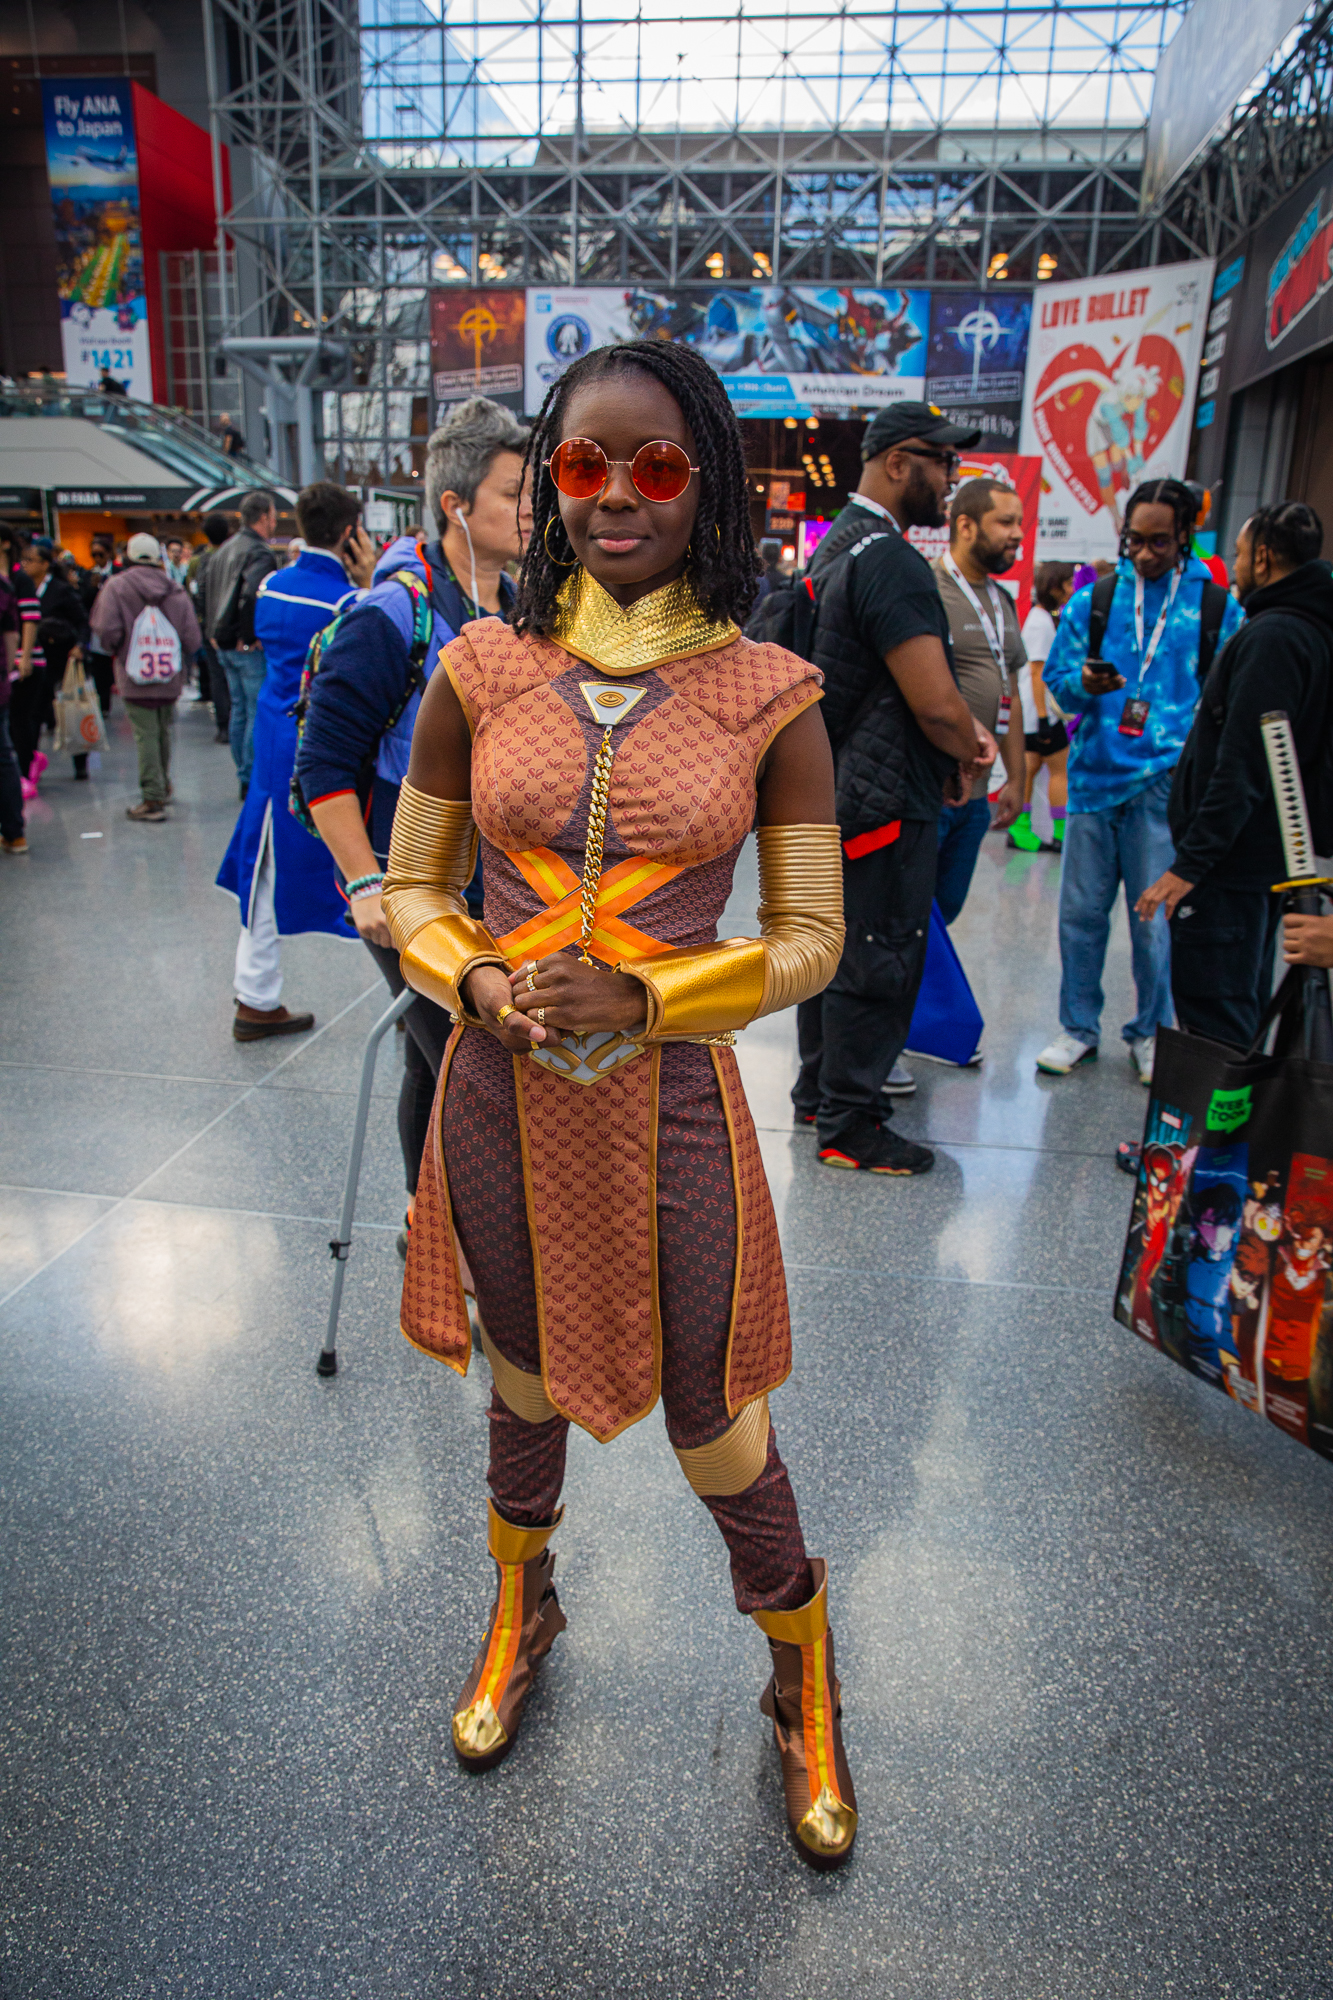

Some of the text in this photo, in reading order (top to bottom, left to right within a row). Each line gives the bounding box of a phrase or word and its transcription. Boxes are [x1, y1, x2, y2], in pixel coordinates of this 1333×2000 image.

[54, 95, 121, 120] Fly ANA
[56, 118, 123, 140] to Japan
[1041, 297, 1081, 330] LOVE
[1086, 287, 1150, 324] BULLET
[140, 652, 173, 678] 35
[1215, 1099, 1245, 1111] WEB
